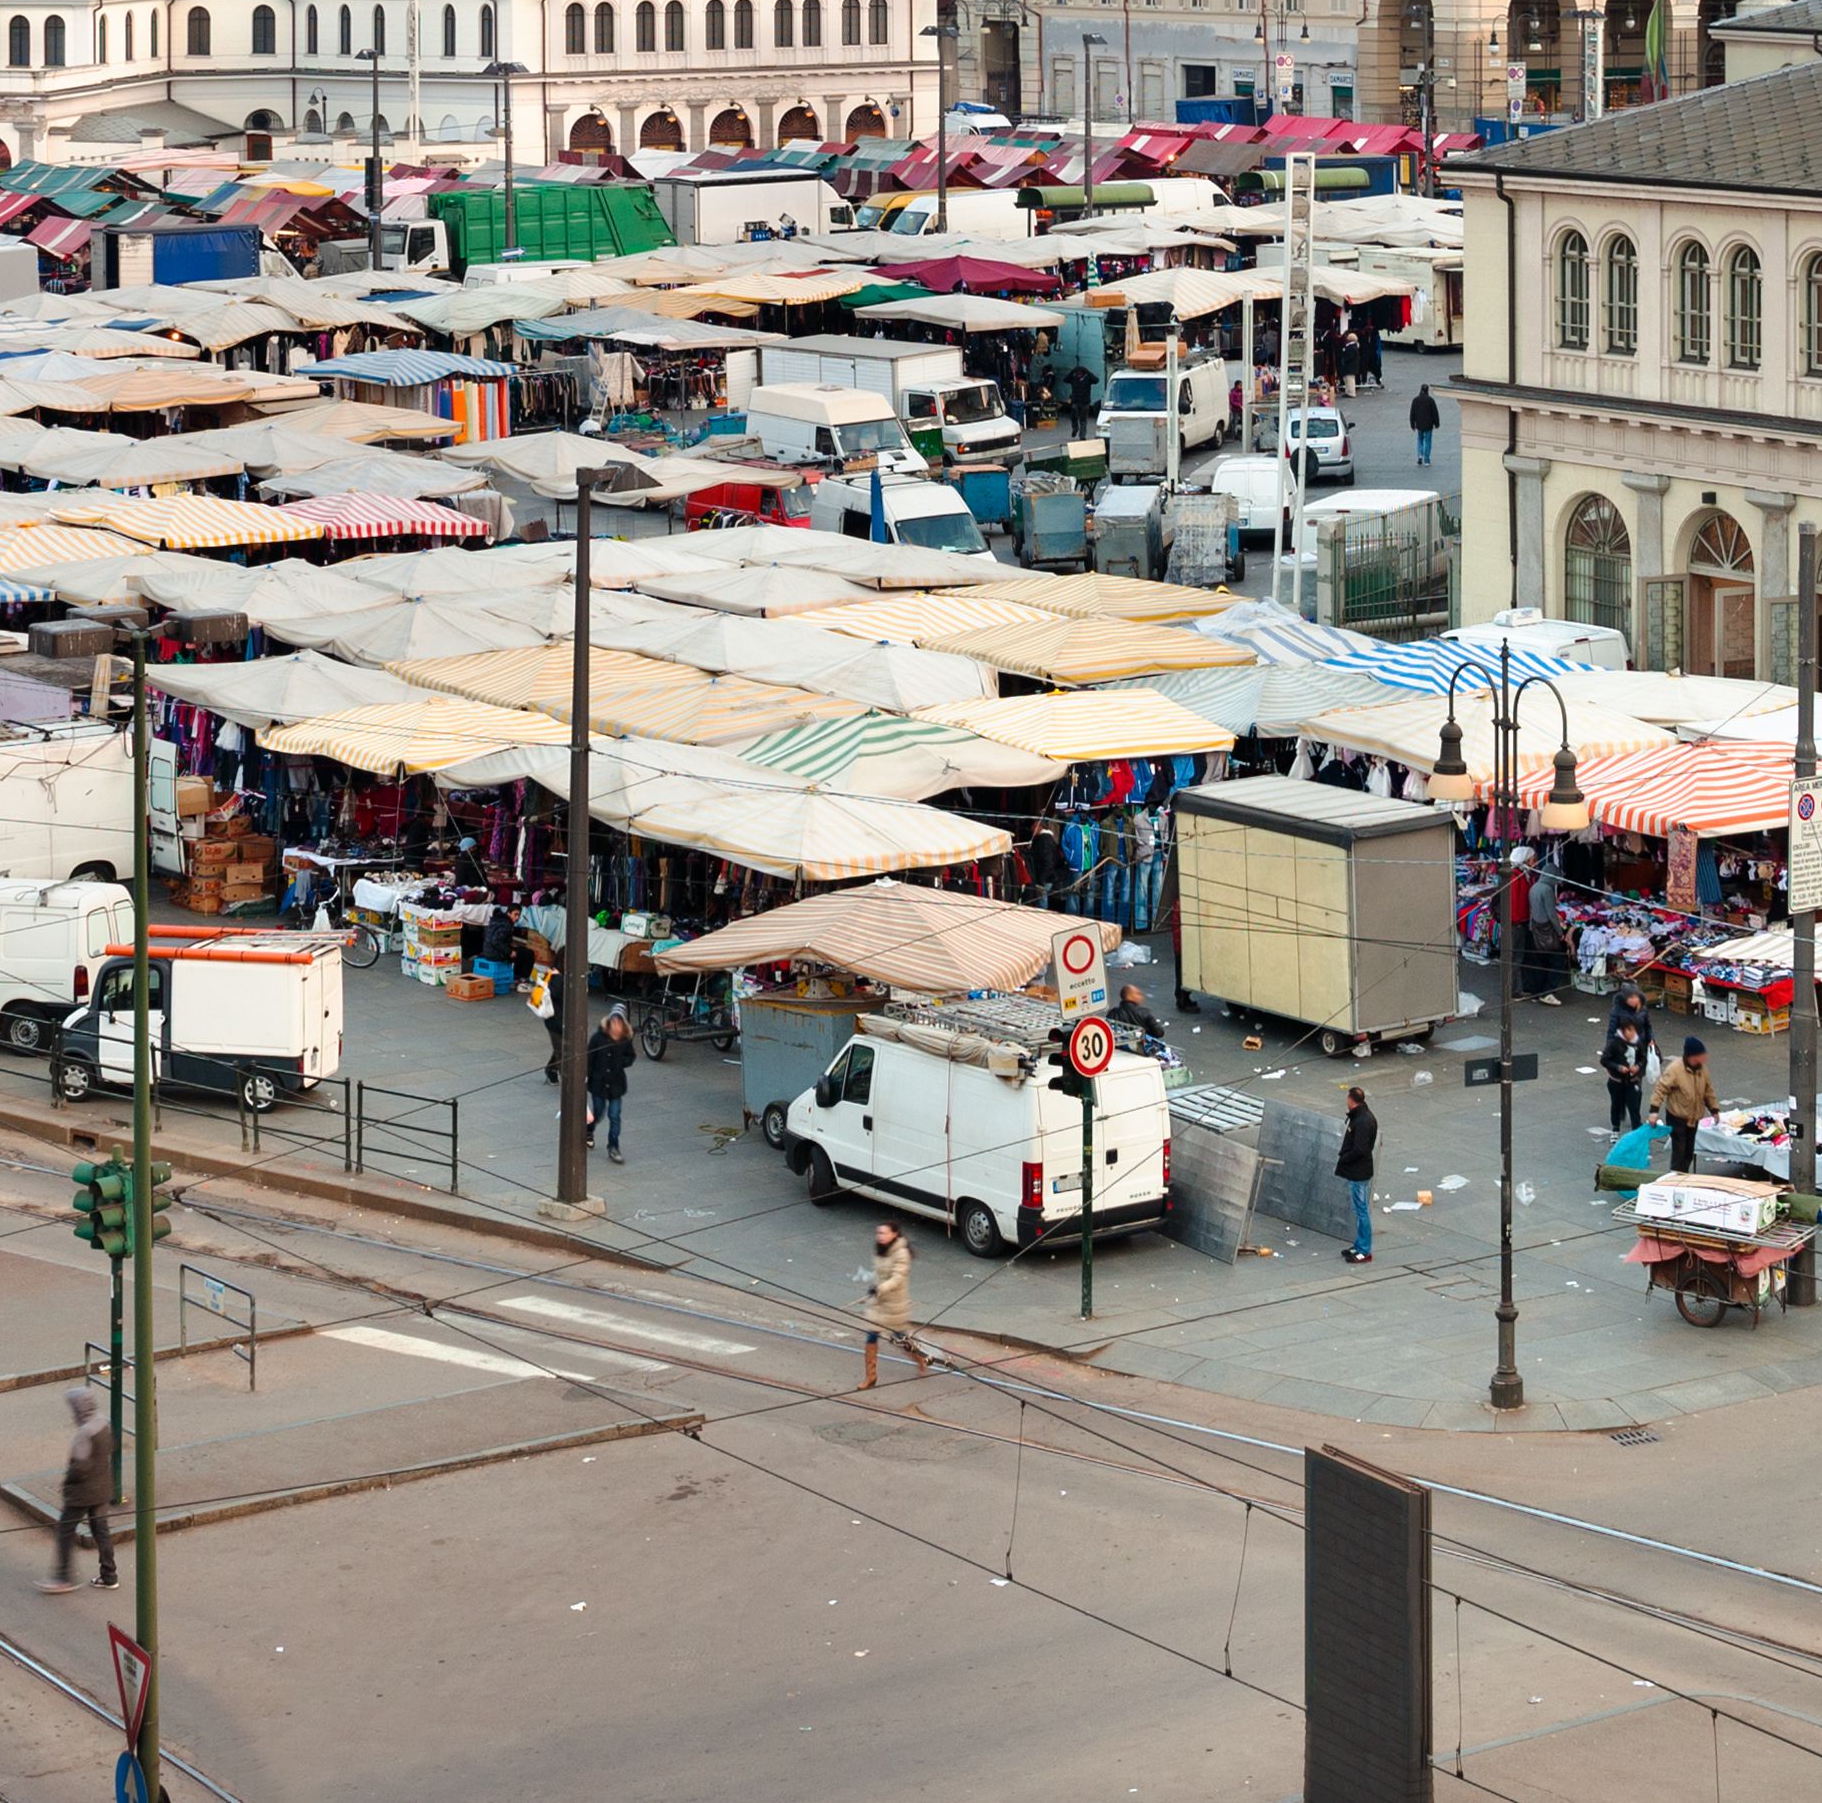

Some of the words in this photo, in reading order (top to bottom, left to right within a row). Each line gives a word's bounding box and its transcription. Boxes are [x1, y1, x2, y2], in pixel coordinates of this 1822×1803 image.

[1794, 782, 1811, 792] AREA
[1069, 977, 1096, 990] eccetto
[1092, 990, 1105, 1003] BUS
[1081, 1032, 1104, 1061] 30
[1056, 1204, 1082, 1213] PEUGEO
